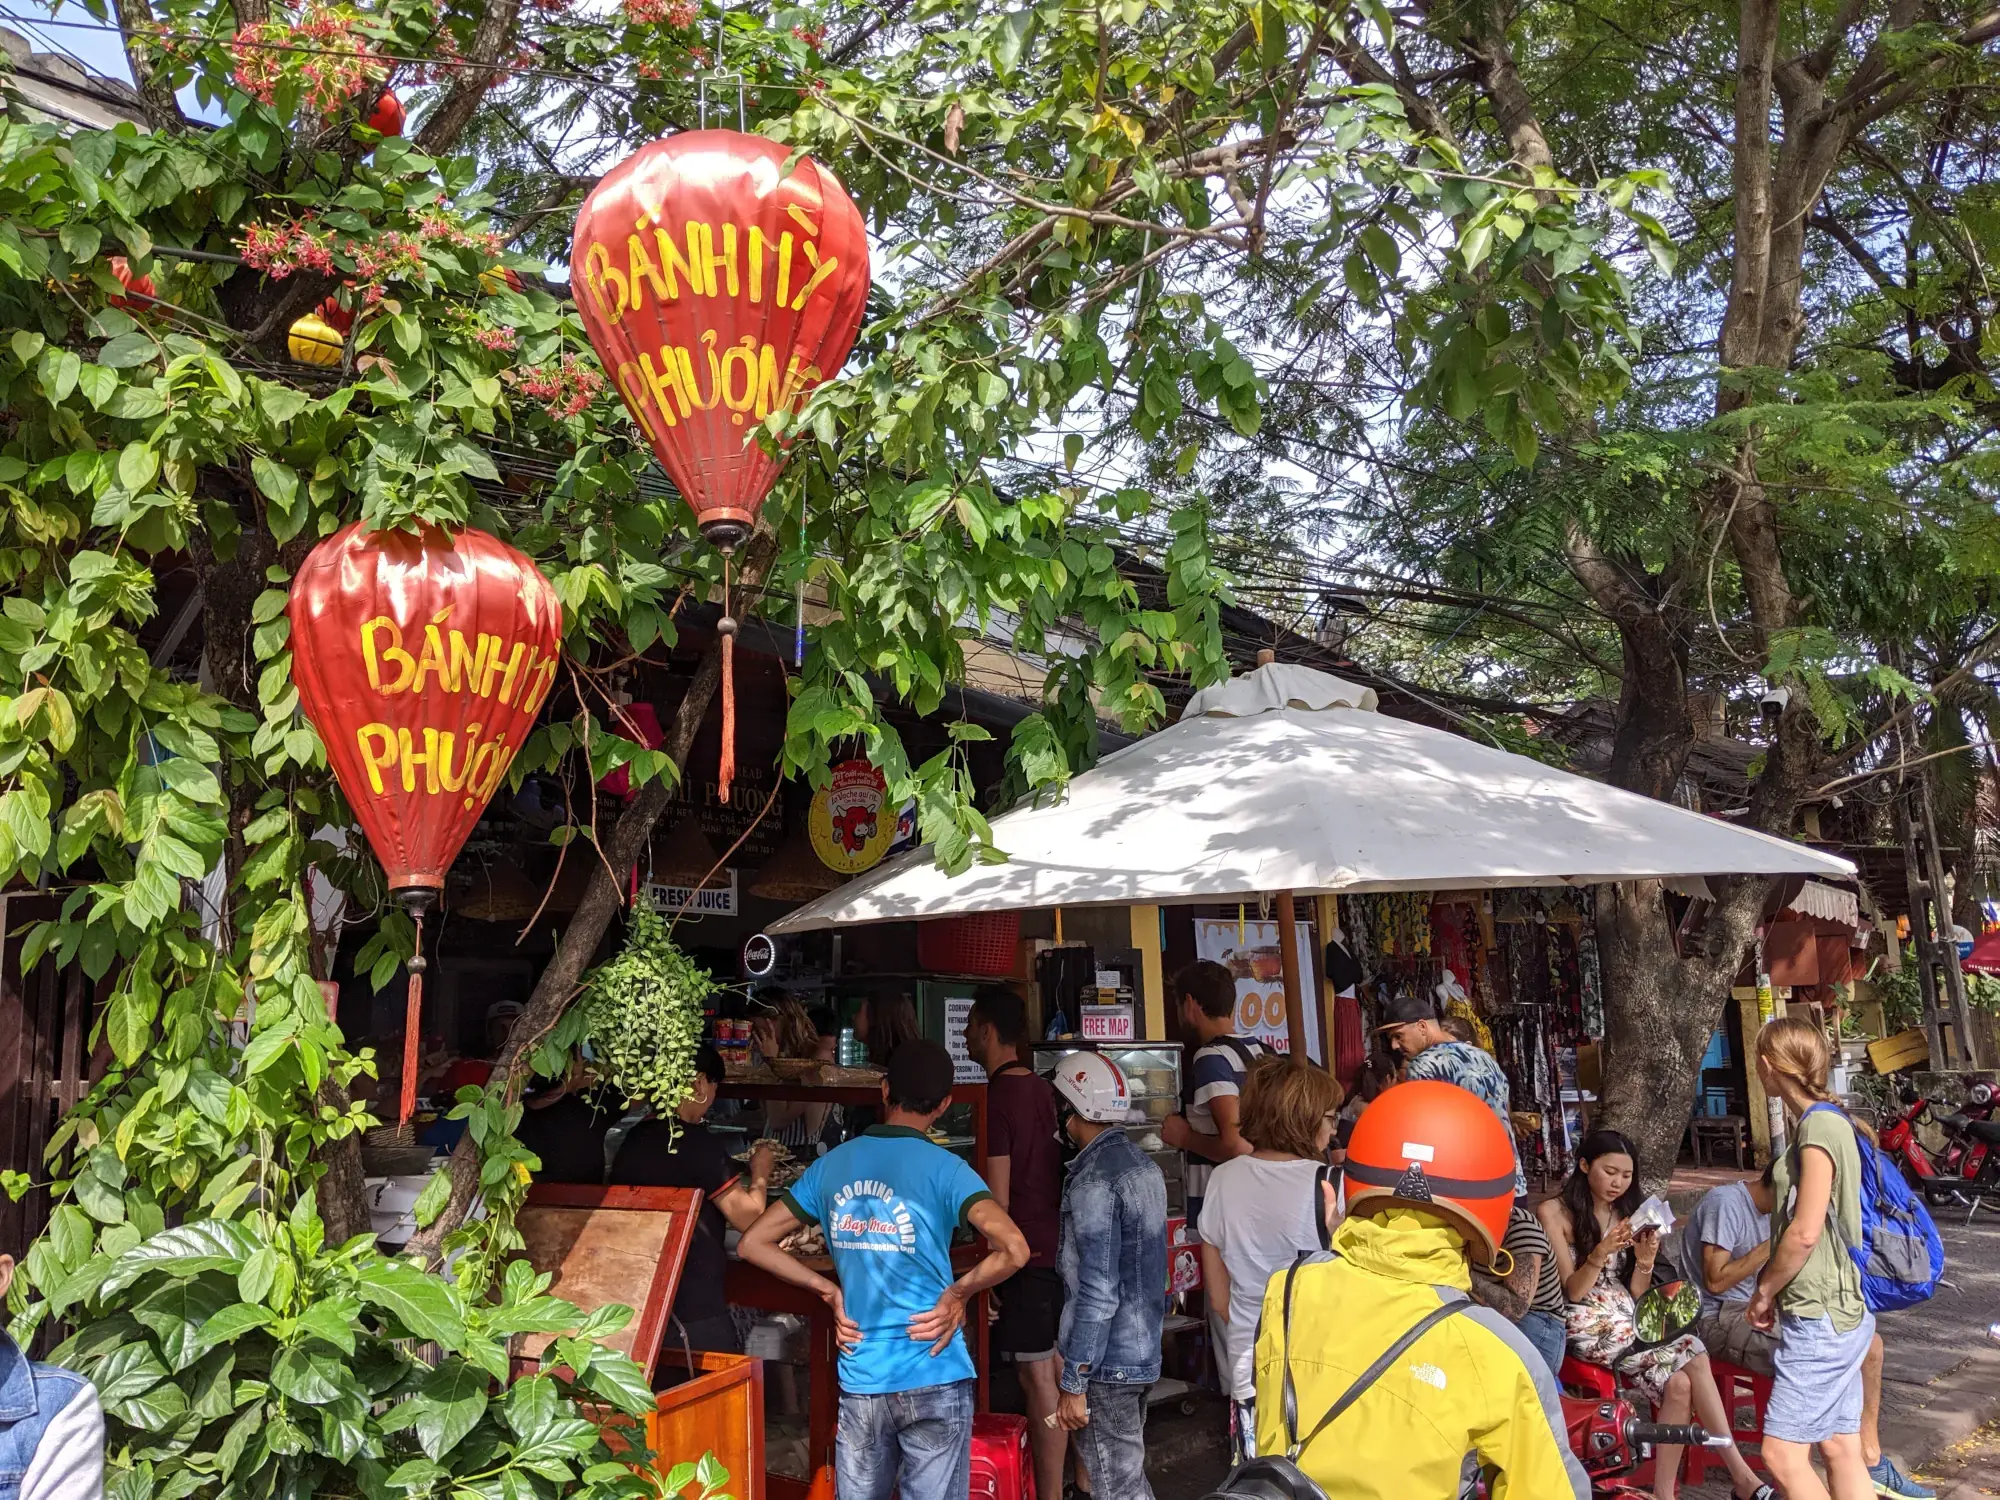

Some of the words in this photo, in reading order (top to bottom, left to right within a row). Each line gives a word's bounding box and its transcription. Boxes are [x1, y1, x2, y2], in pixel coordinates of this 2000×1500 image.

[585, 204, 739, 325] BÁNH
[360, 603, 526, 704] BÁNH
[838, 790, 858, 801] Vache
[859, 791, 869, 799] qui
[652, 887, 692, 907] FRESH
[697, 891, 730, 909] JUICE
[1084, 1018, 1106, 1036] FREE
[1109, 1018, 1129, 1036] MAP
[833, 1180, 894, 1207] COOKING
[829, 1210, 839, 1240] ECO
[839, 1213, 868, 1237] Bay
[892, 1202, 916, 1245] TOUR
